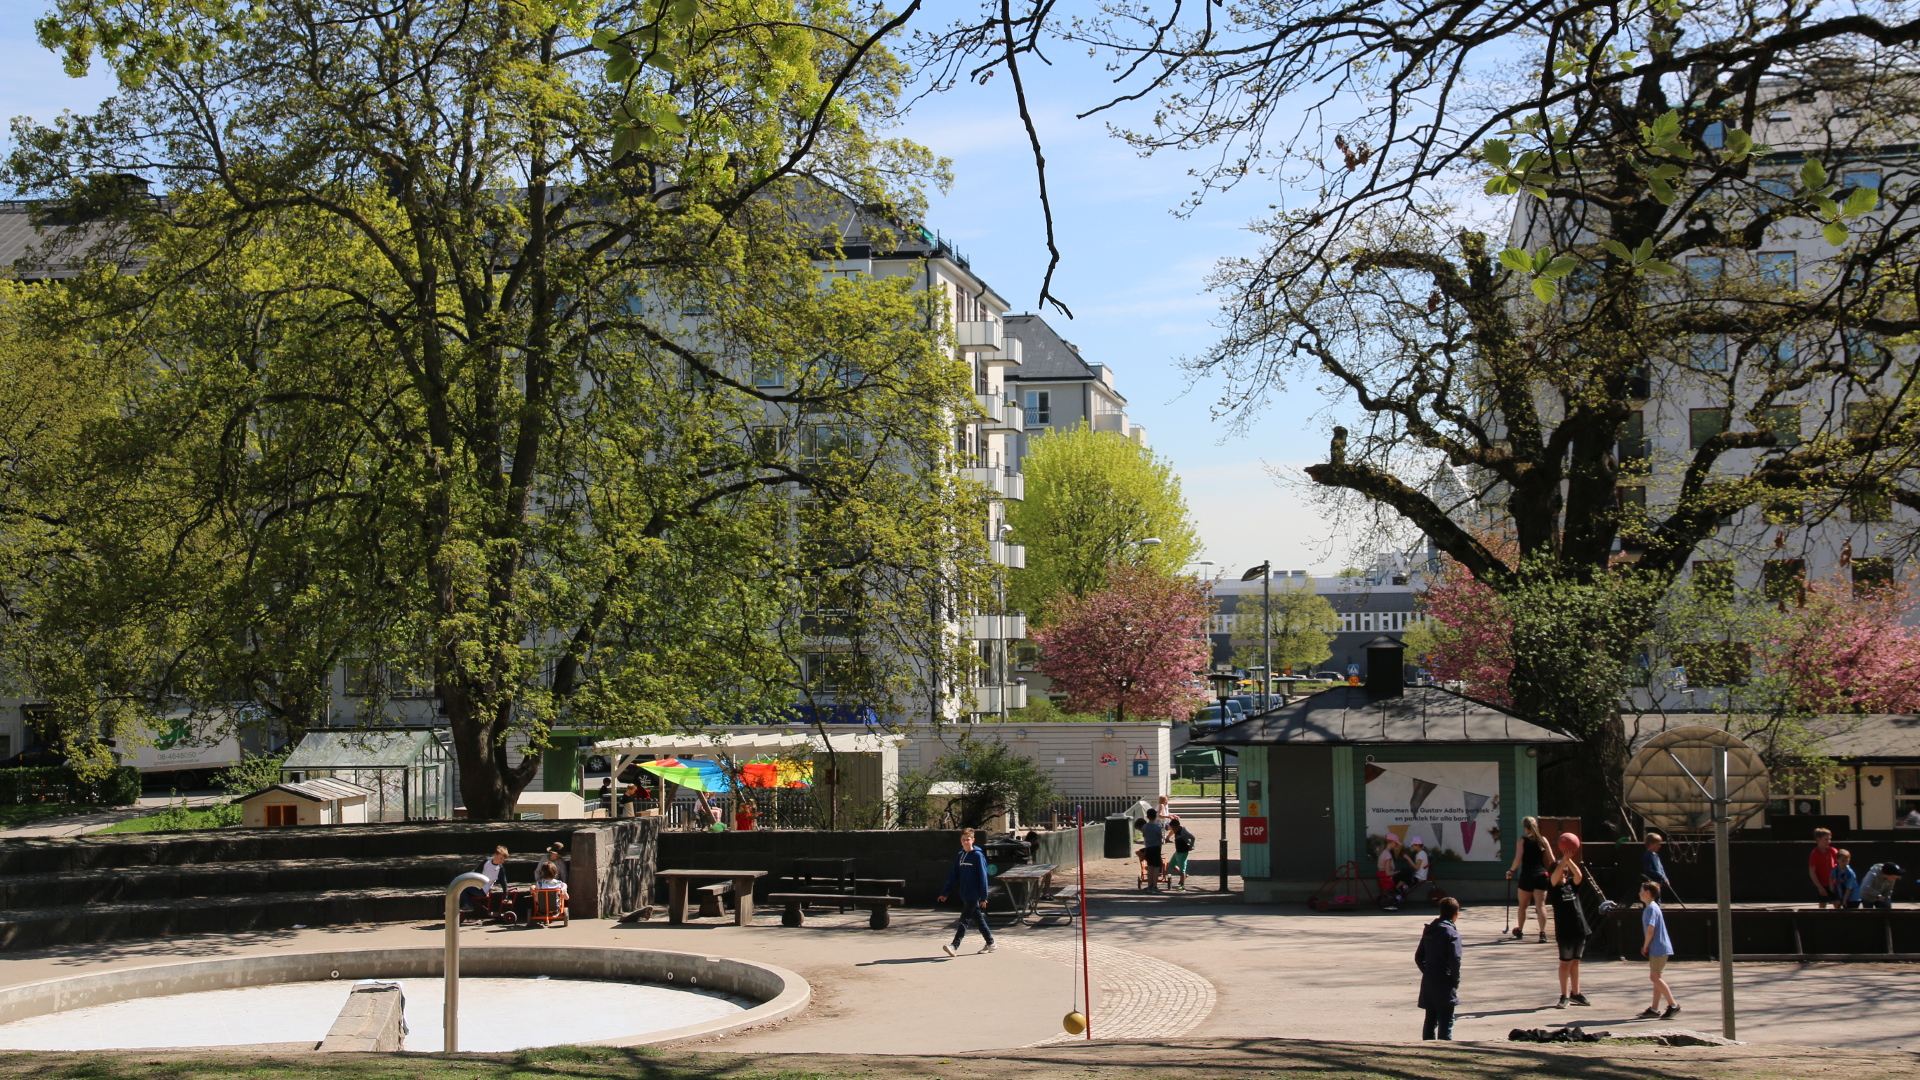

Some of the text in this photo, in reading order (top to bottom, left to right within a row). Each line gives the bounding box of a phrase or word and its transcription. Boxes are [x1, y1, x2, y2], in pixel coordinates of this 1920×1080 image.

[157, 751, 197, 760] 08-4648050
[1137, 763, 1144, 775] P
[1465, 807, 1490, 815] parklek
[1404, 815, 1428, 823] parklek
[1243, 826, 1265, 836] STOP
